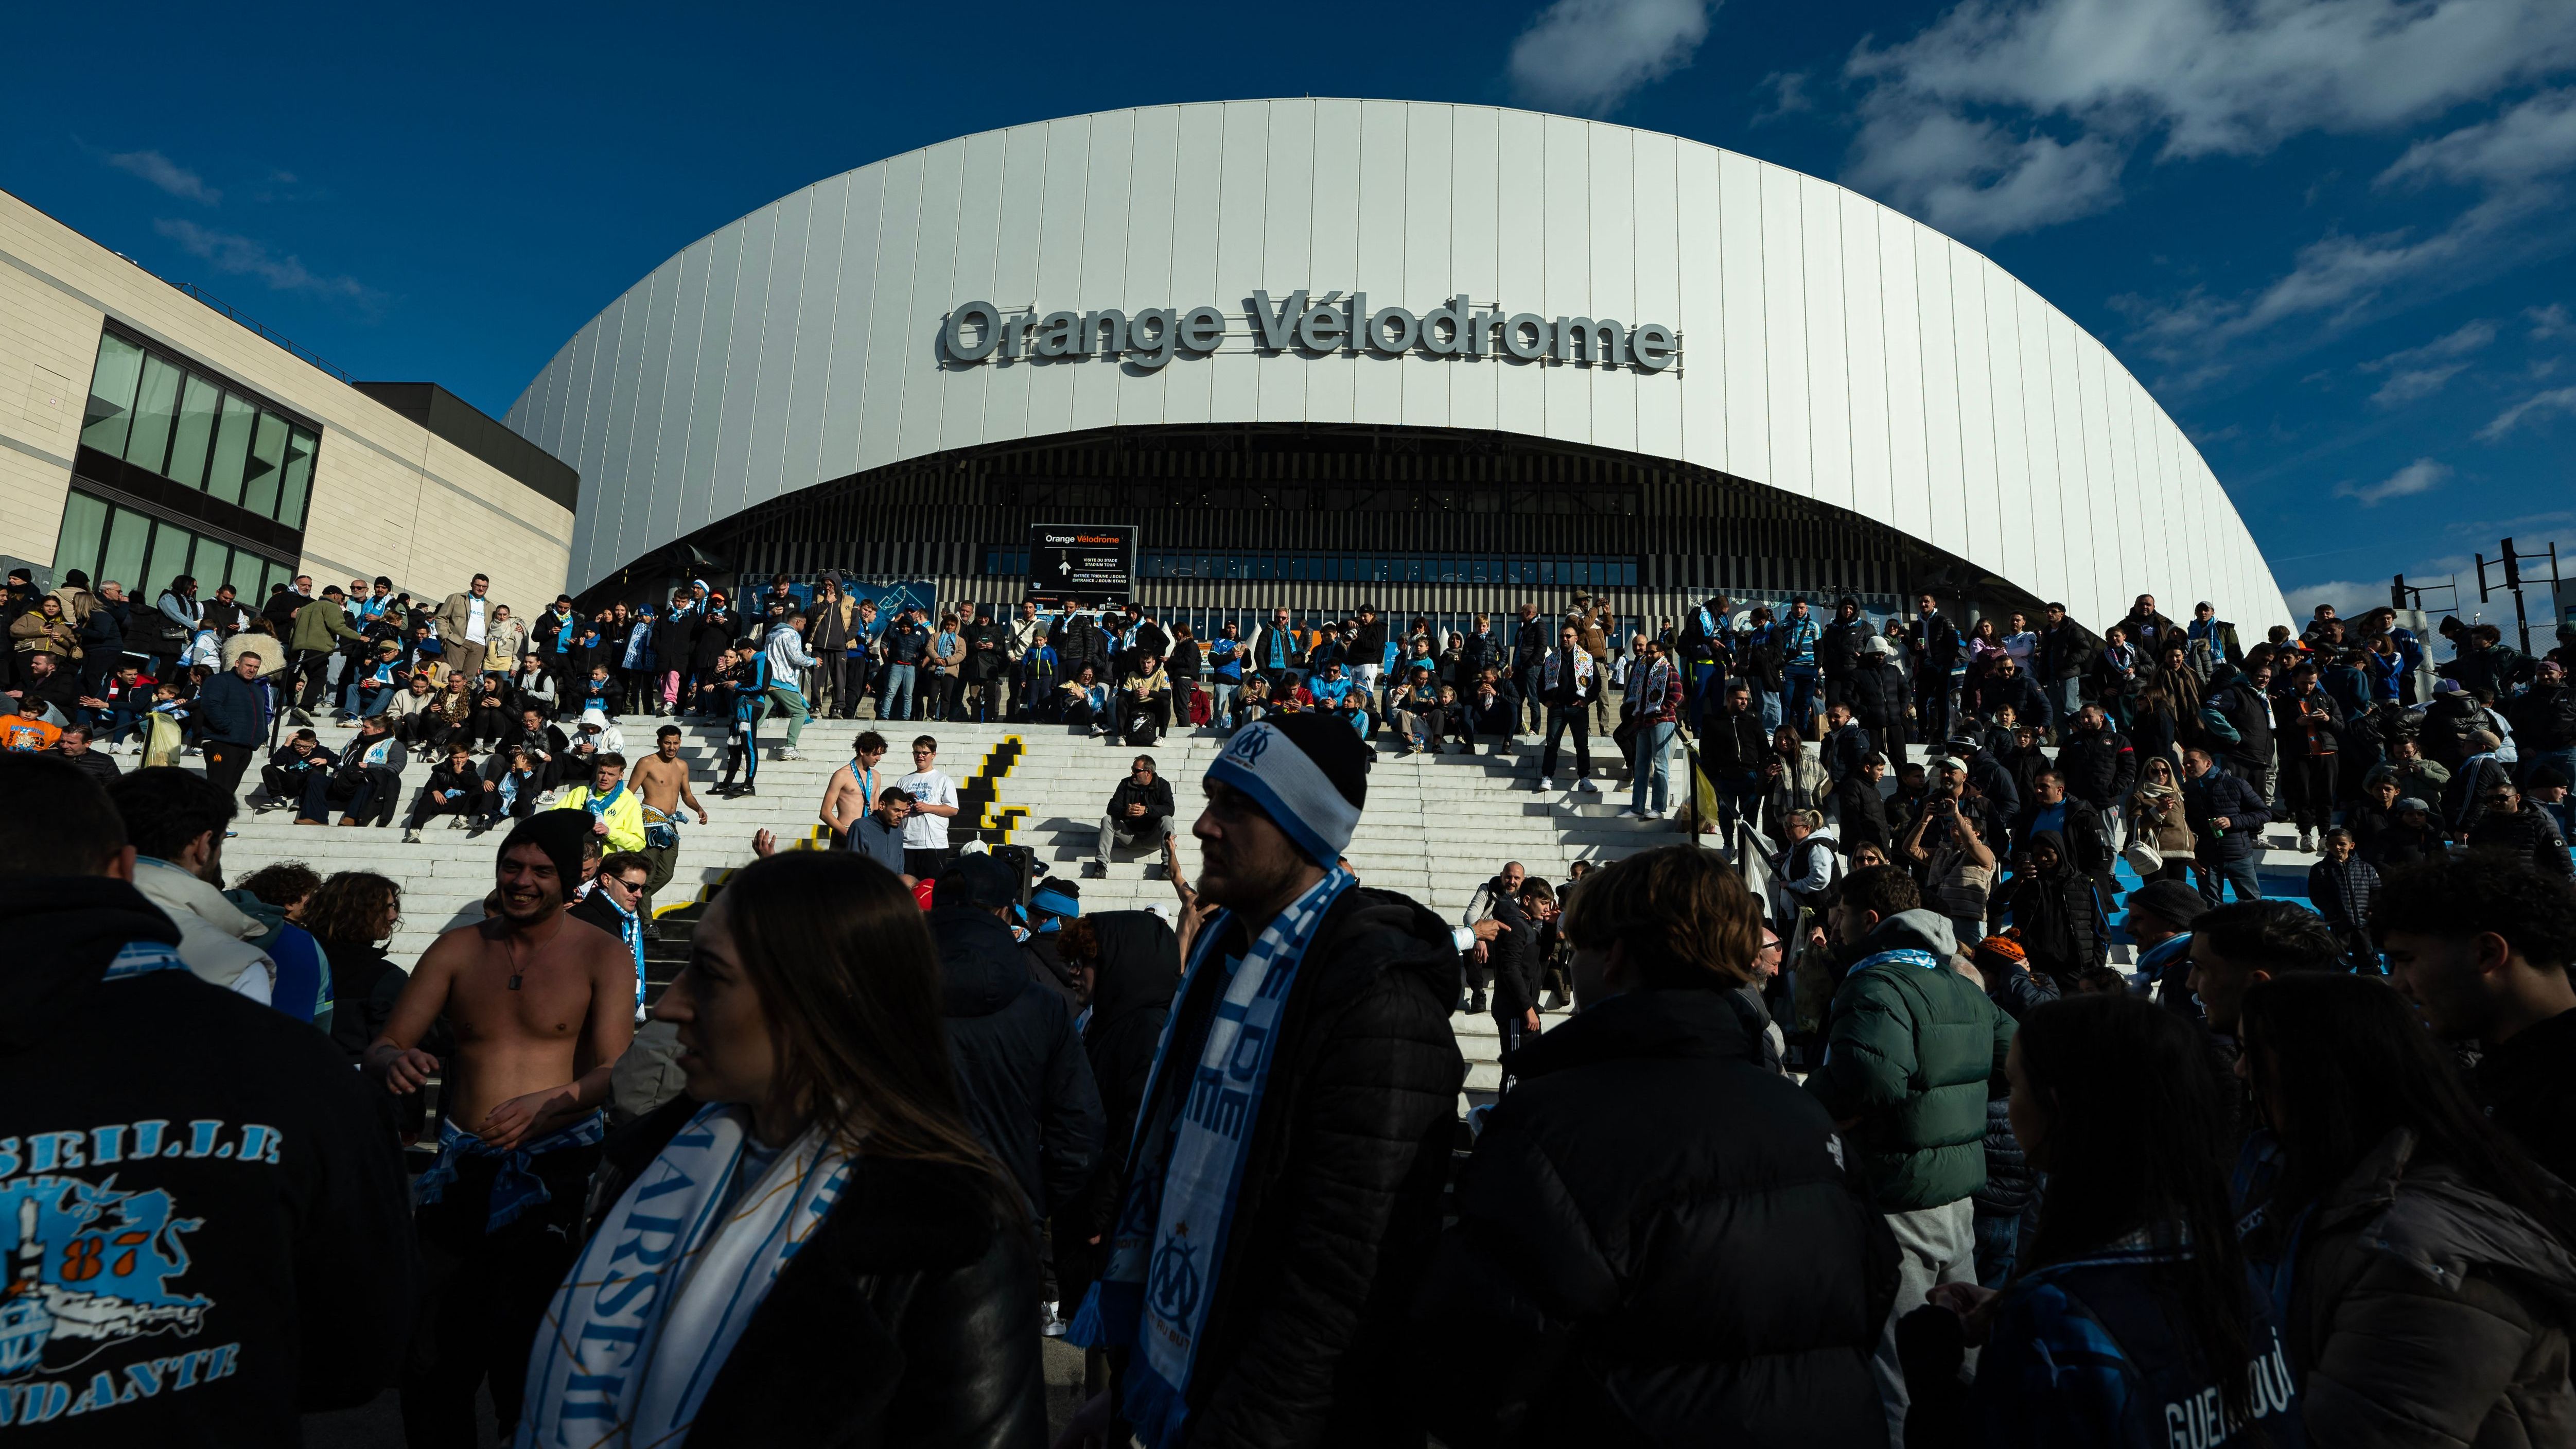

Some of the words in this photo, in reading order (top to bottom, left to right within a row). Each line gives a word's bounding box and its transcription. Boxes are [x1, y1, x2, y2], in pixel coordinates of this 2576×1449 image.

[945, 300, 1226, 368] Orange
[1252, 289, 1676, 370] Vélodrome
[1046, 535, 1075, 544] Orange
[61, 1232, 150, 1282] 87
